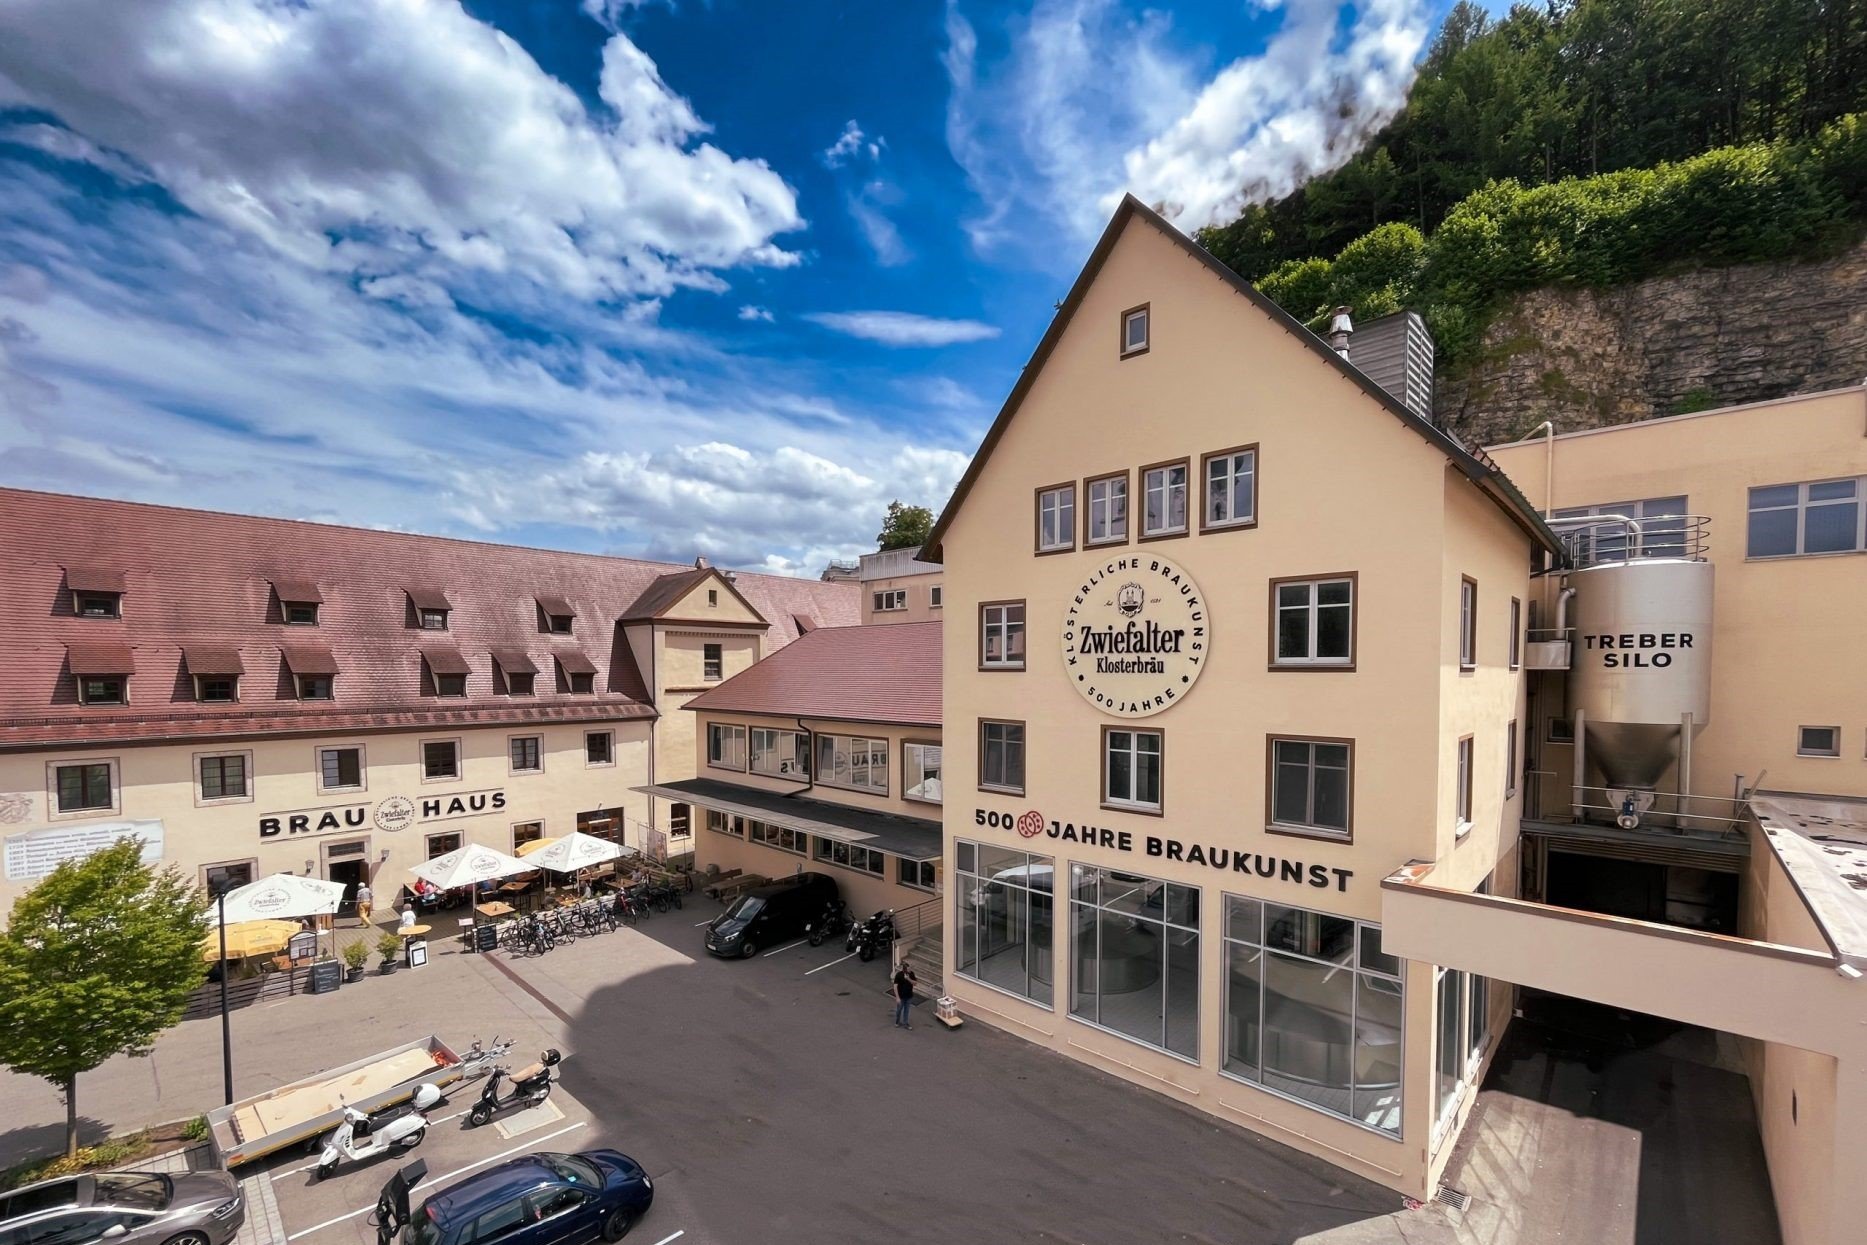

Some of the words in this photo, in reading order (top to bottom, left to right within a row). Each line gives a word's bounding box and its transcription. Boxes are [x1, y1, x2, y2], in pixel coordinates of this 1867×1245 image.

[1063, 558, 1139, 666] KLÖSTERLICHE
[1150, 560, 1204, 665] BRAUKUNST
[1080, 621, 1185, 654] Zwiefalter
[1584, 633, 1693, 649] TREBER
[1096, 656, 1165, 674] Klosterbräu
[1603, 652, 1672, 668] SILO
[1087, 686, 1114, 708] 500
[1119, 688, 1176, 713] JAHRE
[260, 807, 366, 838] BRAU
[423, 792, 506, 818] HAUS
[975, 808, 1014, 831] 500
[1046, 820, 1132, 852] JAHRE
[1145, 836, 1354, 893] BRAUKUNST
